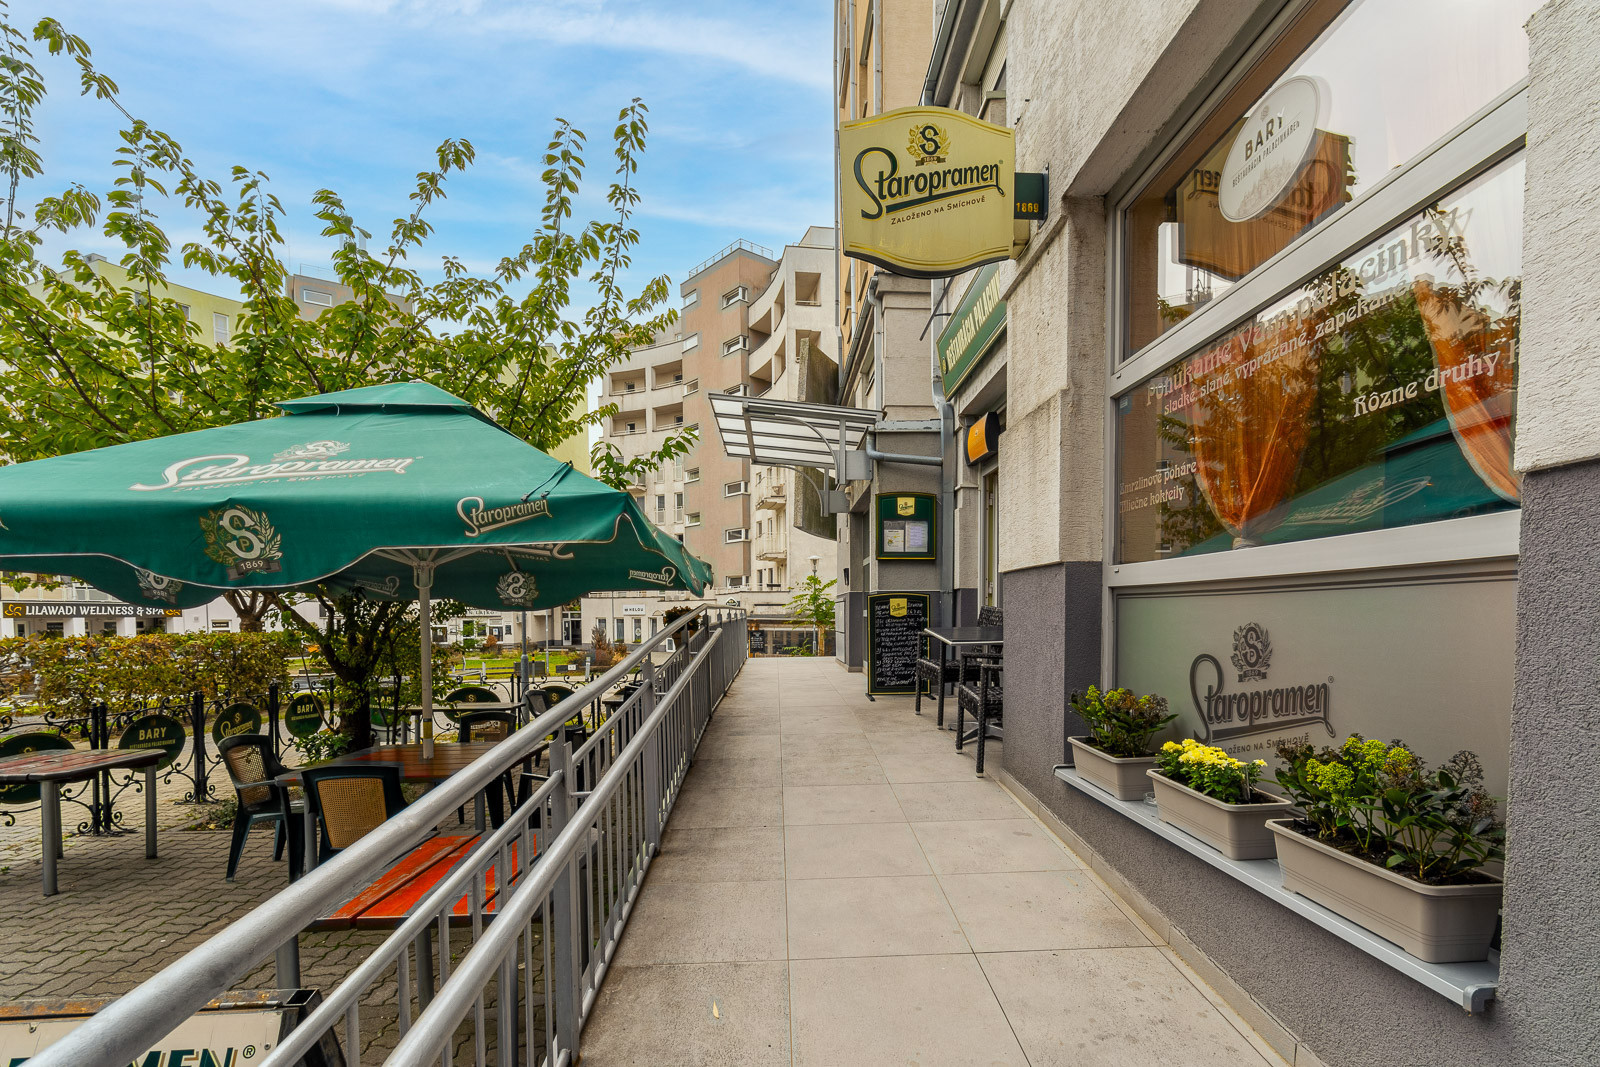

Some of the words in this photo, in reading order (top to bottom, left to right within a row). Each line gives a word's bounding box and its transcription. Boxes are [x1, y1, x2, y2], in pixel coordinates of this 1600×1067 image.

[1245, 106, 1285, 161] BARY
[853, 146, 1006, 220] Staropramen
[1015, 202, 1039, 213] 1869
[1352, 381, 1418, 418] Rôzne
[1424, 350, 1501, 393] druhy
[128, 452, 414, 492] Staropramen
[1163, 461, 1197, 485] poháre
[1149, 484, 1185, 506] kokteily
[456, 496, 552, 538] Staropramen
[240, 560, 264, 570] 1869
[26, 605, 77, 616] LILAWADI
[79, 605, 134, 616] WELLNESS
[136, 607, 144, 616] &
[146, 607, 165, 616] SPA
[296, 703, 315, 714] BARY
[1190, 653, 1336, 746] Staropramen
[139, 726, 167, 741] BARY
[1253, 742, 1264, 751] NA
